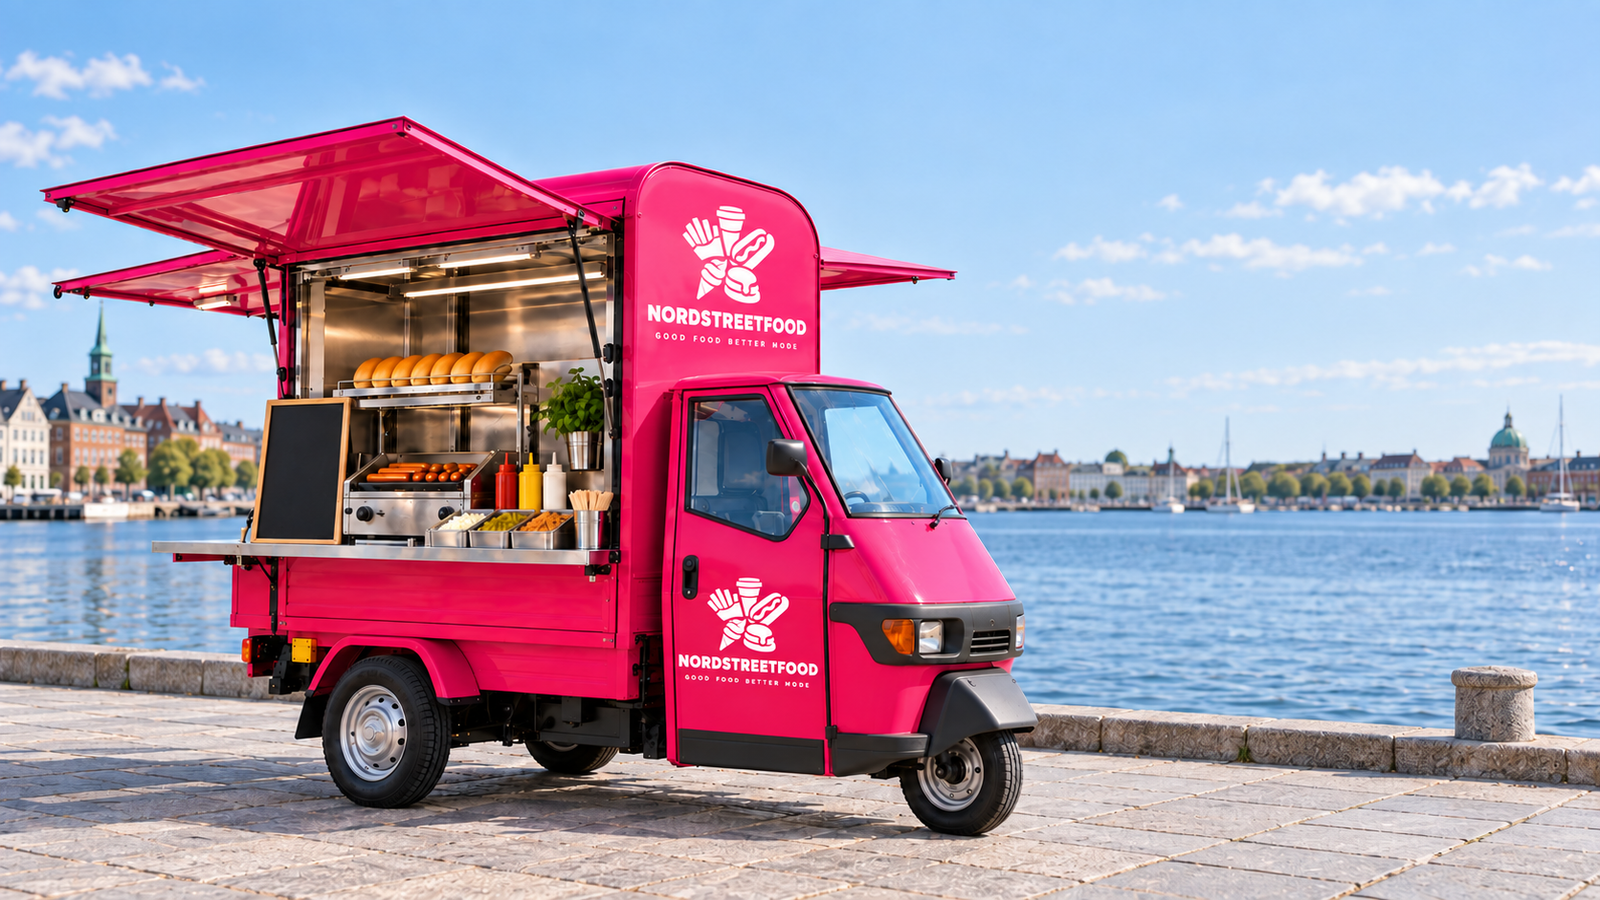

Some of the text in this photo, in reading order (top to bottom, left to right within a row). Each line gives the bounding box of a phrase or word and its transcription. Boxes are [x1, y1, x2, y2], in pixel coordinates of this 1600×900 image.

[647, 304, 807, 335] NORDSTREETFOOD
[655, 332, 686, 341] GOOD
[693, 335, 721, 344] FOOD
[728, 338, 766, 348] BETTER
[678, 654, 819, 676] NORDSTREETFOOD
